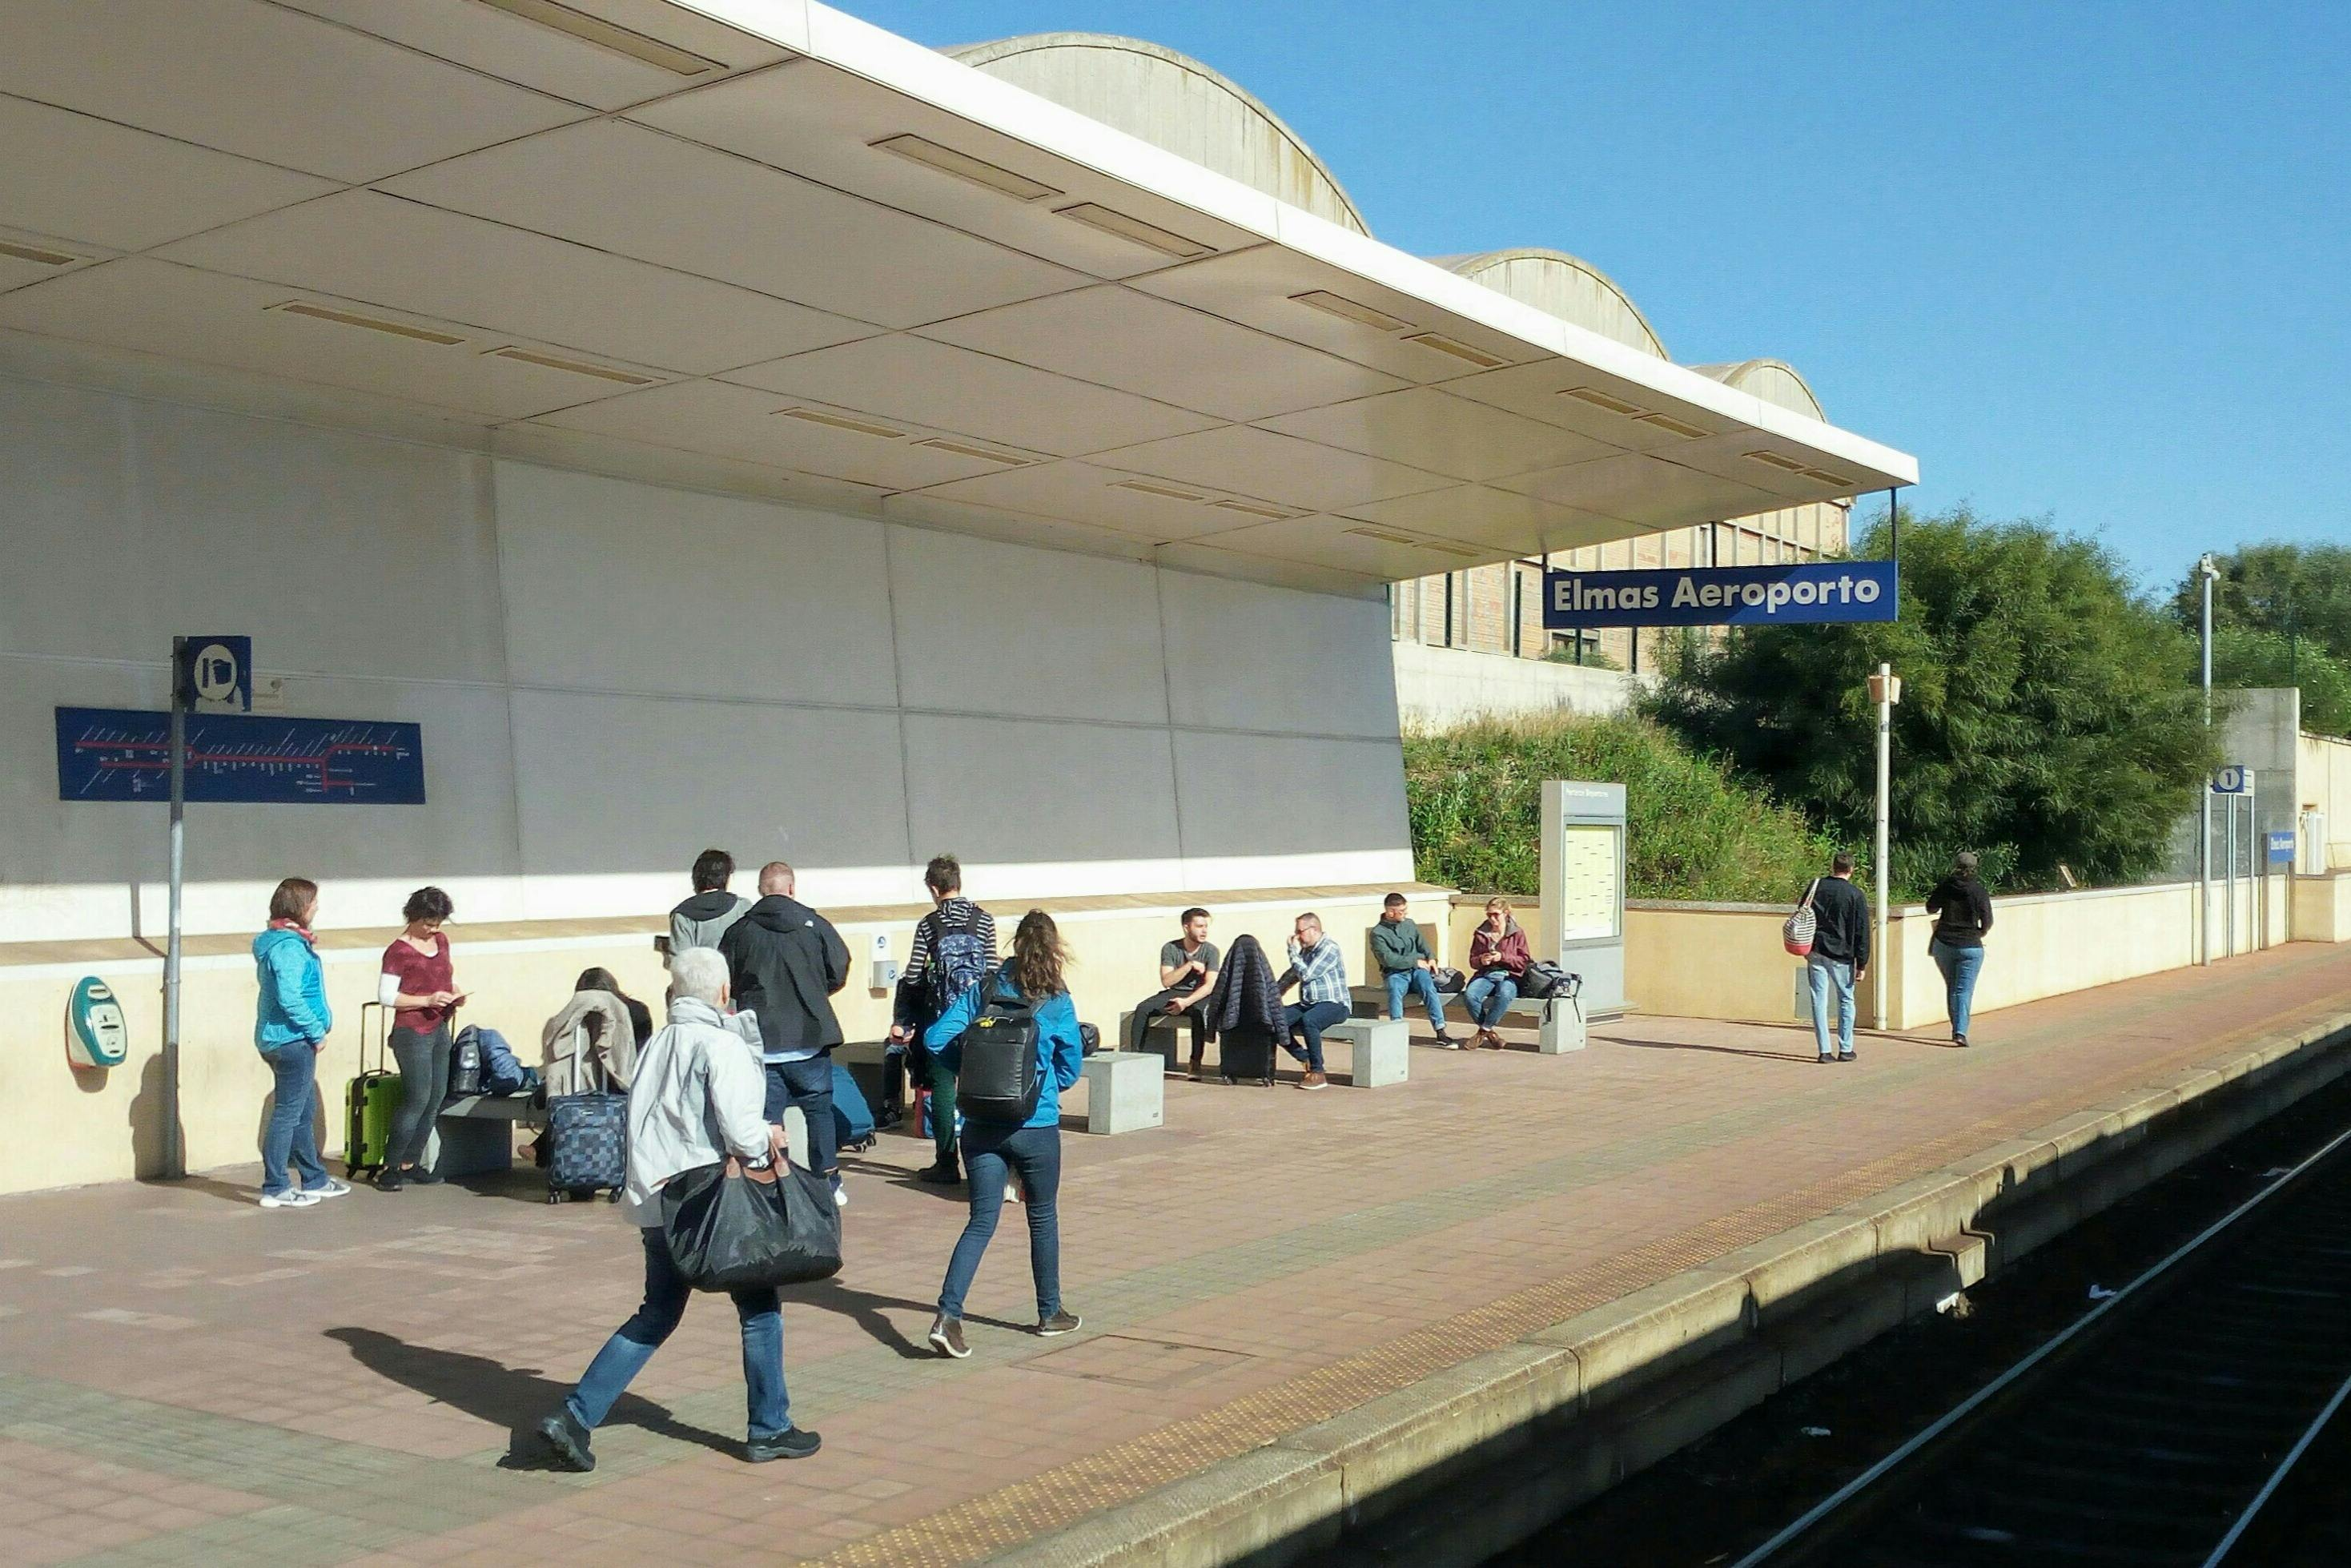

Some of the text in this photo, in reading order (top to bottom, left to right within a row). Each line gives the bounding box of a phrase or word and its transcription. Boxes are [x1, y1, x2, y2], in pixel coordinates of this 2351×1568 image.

[1554, 576, 1880, 613] Elmas Aeroporto
[2225, 772, 2232, 786] 1
